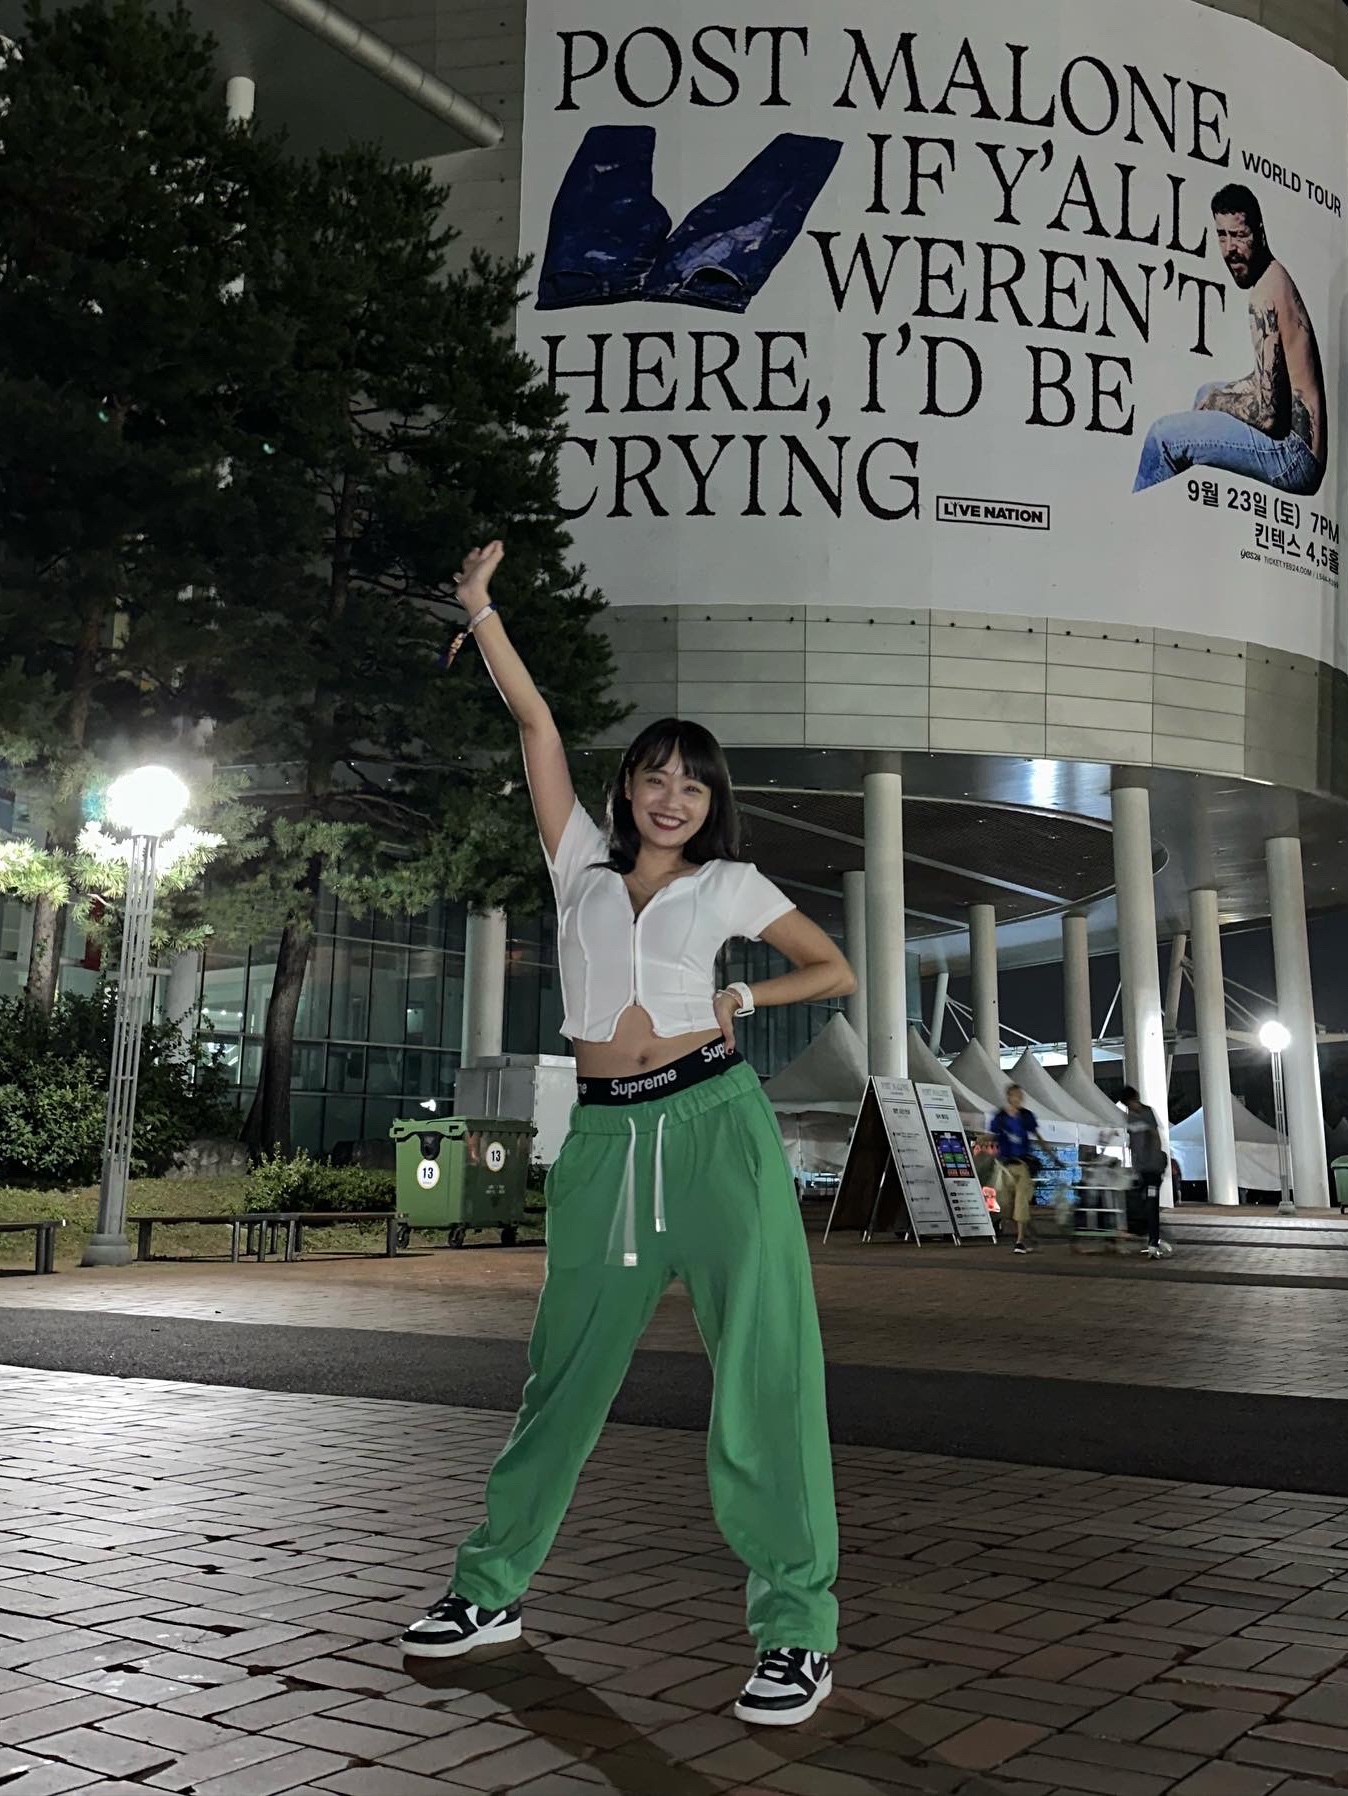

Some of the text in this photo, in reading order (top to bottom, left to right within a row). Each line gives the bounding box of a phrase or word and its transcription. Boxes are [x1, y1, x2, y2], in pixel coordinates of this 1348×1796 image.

[554, 25, 1230, 167] POST MALONE
[865, 133, 1207, 258] IF Y'ALL
[1242, 150, 1341, 218] WORLD TOUR
[807, 231, 1226, 357] WEREN'T
[541, 322, 1135, 435] HERE, I'D BE
[551, 434, 919, 520] CRYING
[944, 502, 1043, 523] LIVE NATION
[1187, 479, 1339, 545] 9월 23일 (토) 7PM
[1254, 522, 1339, 576] 킨텍스 4,5홀
[610, 1068, 678, 1099] Supreme
[701, 1043, 726, 1063] Sup
[422, 1167, 434, 1179] 13
[491, 1150, 501, 1162] 13
